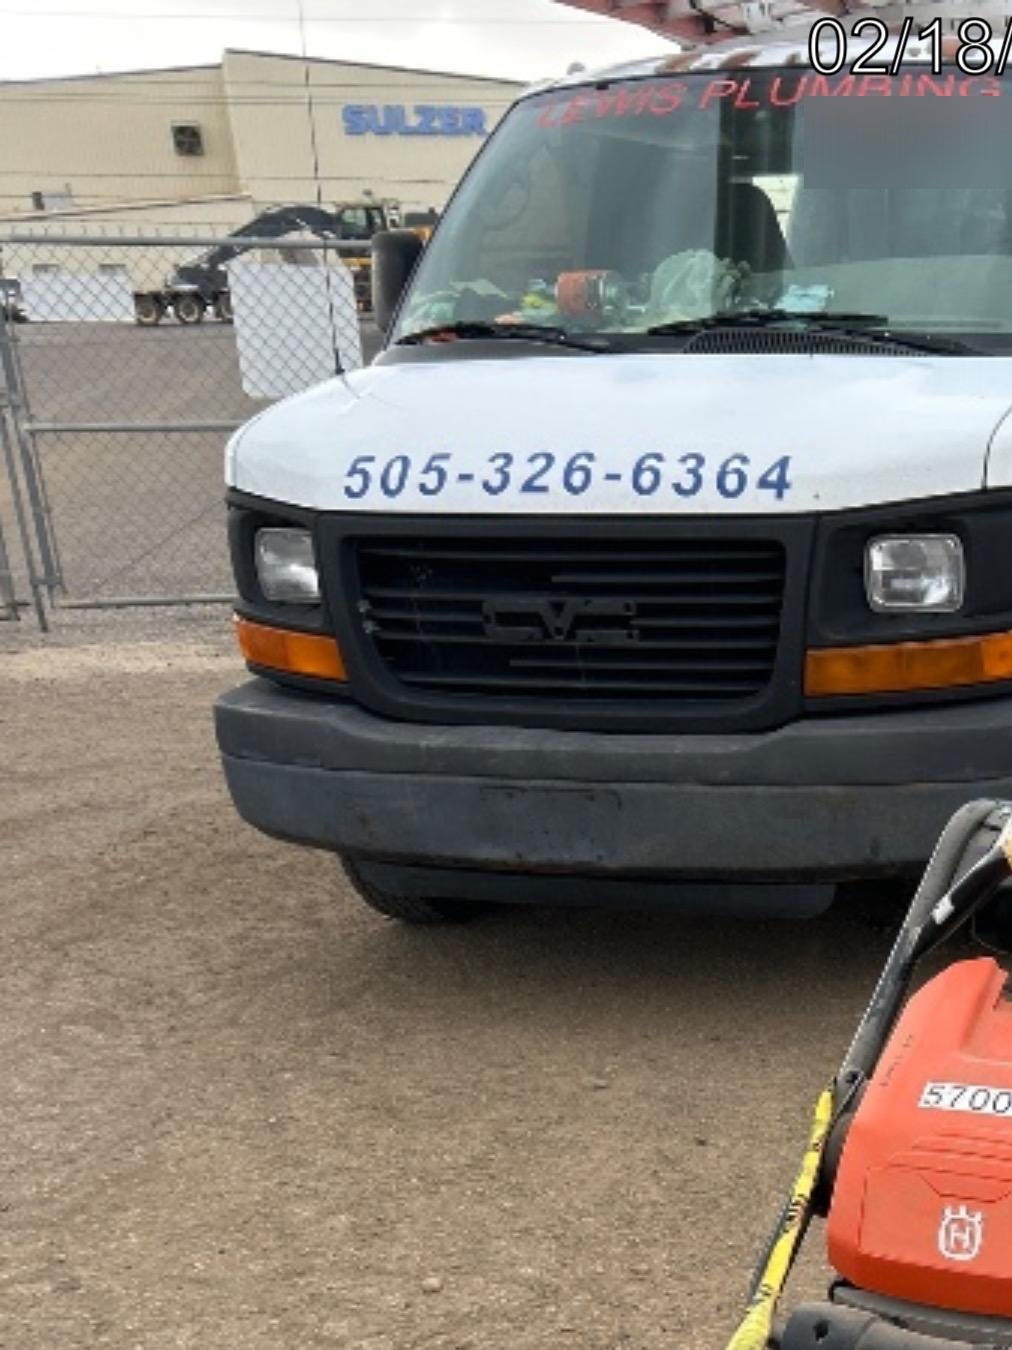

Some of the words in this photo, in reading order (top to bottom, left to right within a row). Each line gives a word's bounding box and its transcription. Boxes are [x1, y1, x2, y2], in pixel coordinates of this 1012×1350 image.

[342, 104, 488, 136] SULZER
[537, 82, 688, 128] LEWIS
[700, 73, 1004, 108] PLUMBING
[344, 451, 792, 501] 505-326-6364
